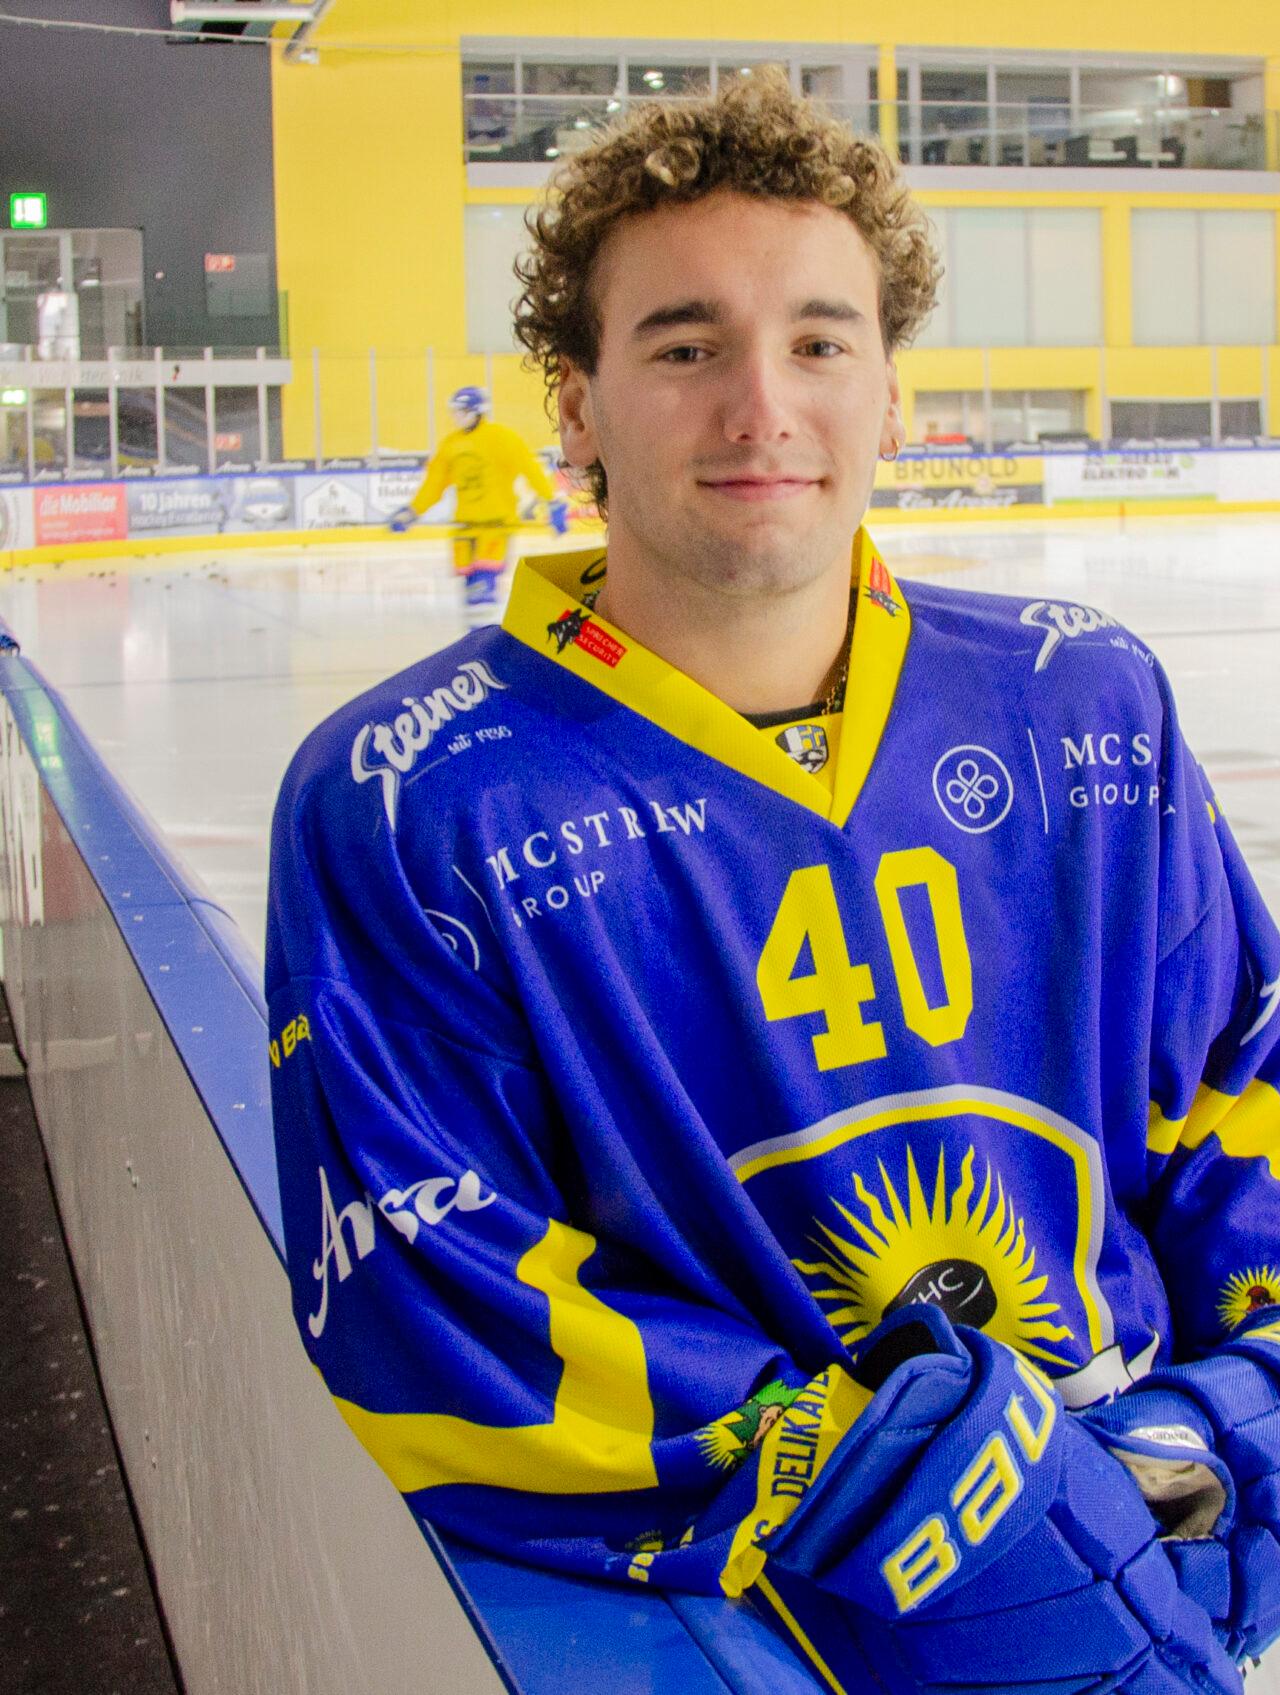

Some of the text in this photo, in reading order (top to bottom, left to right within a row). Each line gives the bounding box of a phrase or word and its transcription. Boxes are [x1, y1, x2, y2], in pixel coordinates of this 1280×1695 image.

[140, 492, 157, 511] 10
[351, 660, 511, 832] Steiner
[756, 846, 974, 1072] 40
[308, 1166, 497, 1338] Arsa
[910, 1267, 964, 1305] HC
